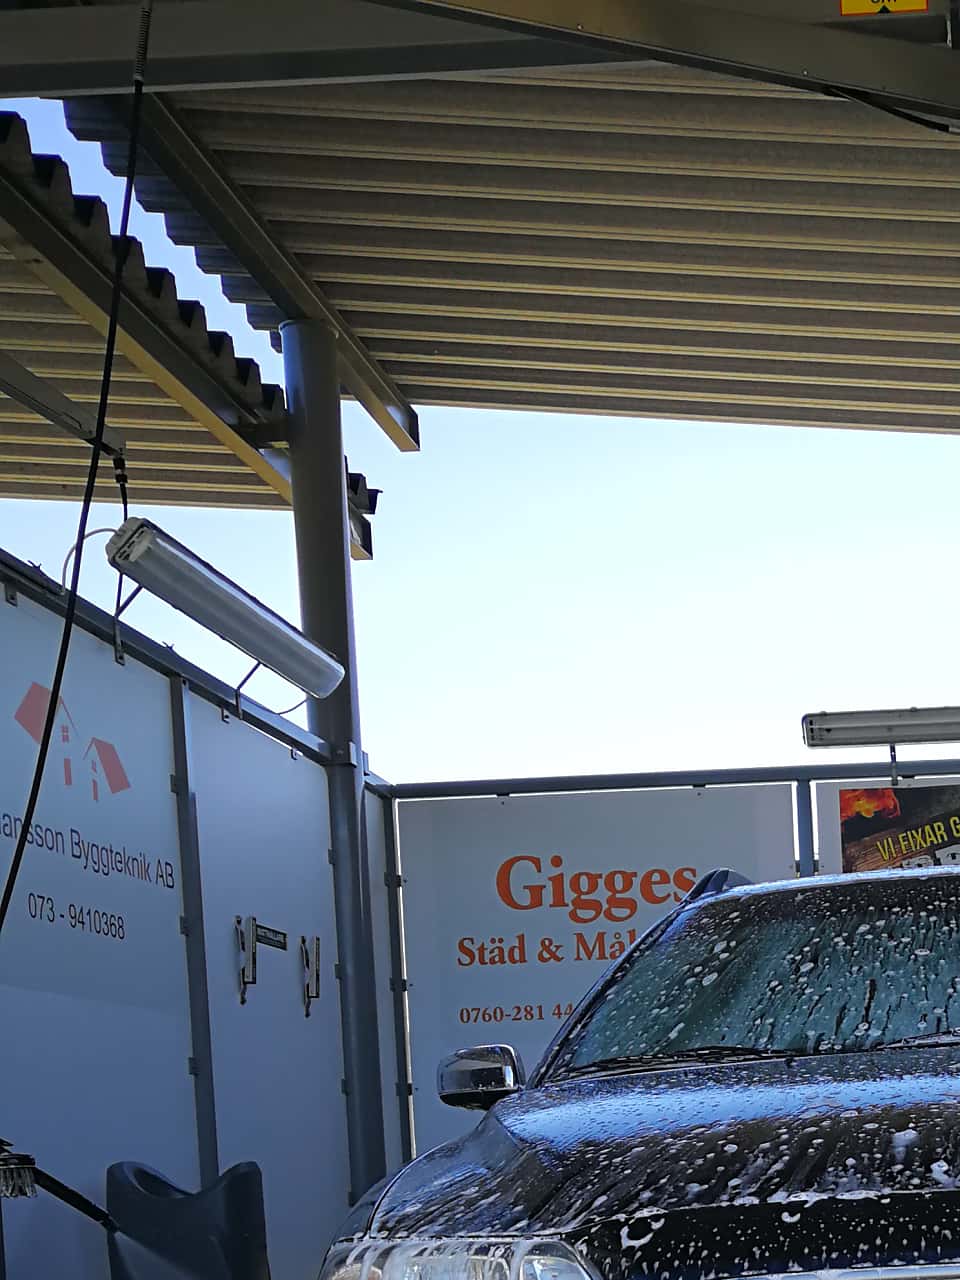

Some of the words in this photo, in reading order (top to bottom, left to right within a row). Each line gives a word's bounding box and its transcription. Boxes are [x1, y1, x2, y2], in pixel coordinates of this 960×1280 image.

[0, 812, 66, 855] ansson
[70, 827, 152, 883] Byggteknik
[155, 858, 175, 889] AB
[876, 836, 897, 861] VI
[899, 821, 948, 854] FIXAR
[495, 854, 698, 924] Gigges
[28, 892, 56, 923] 073
[68, 903, 126, 940] 9410368
[456, 933, 528, 967] Städ
[537, 937, 565, 964] &
[458, 1004, 545, 1024] 0760-281
